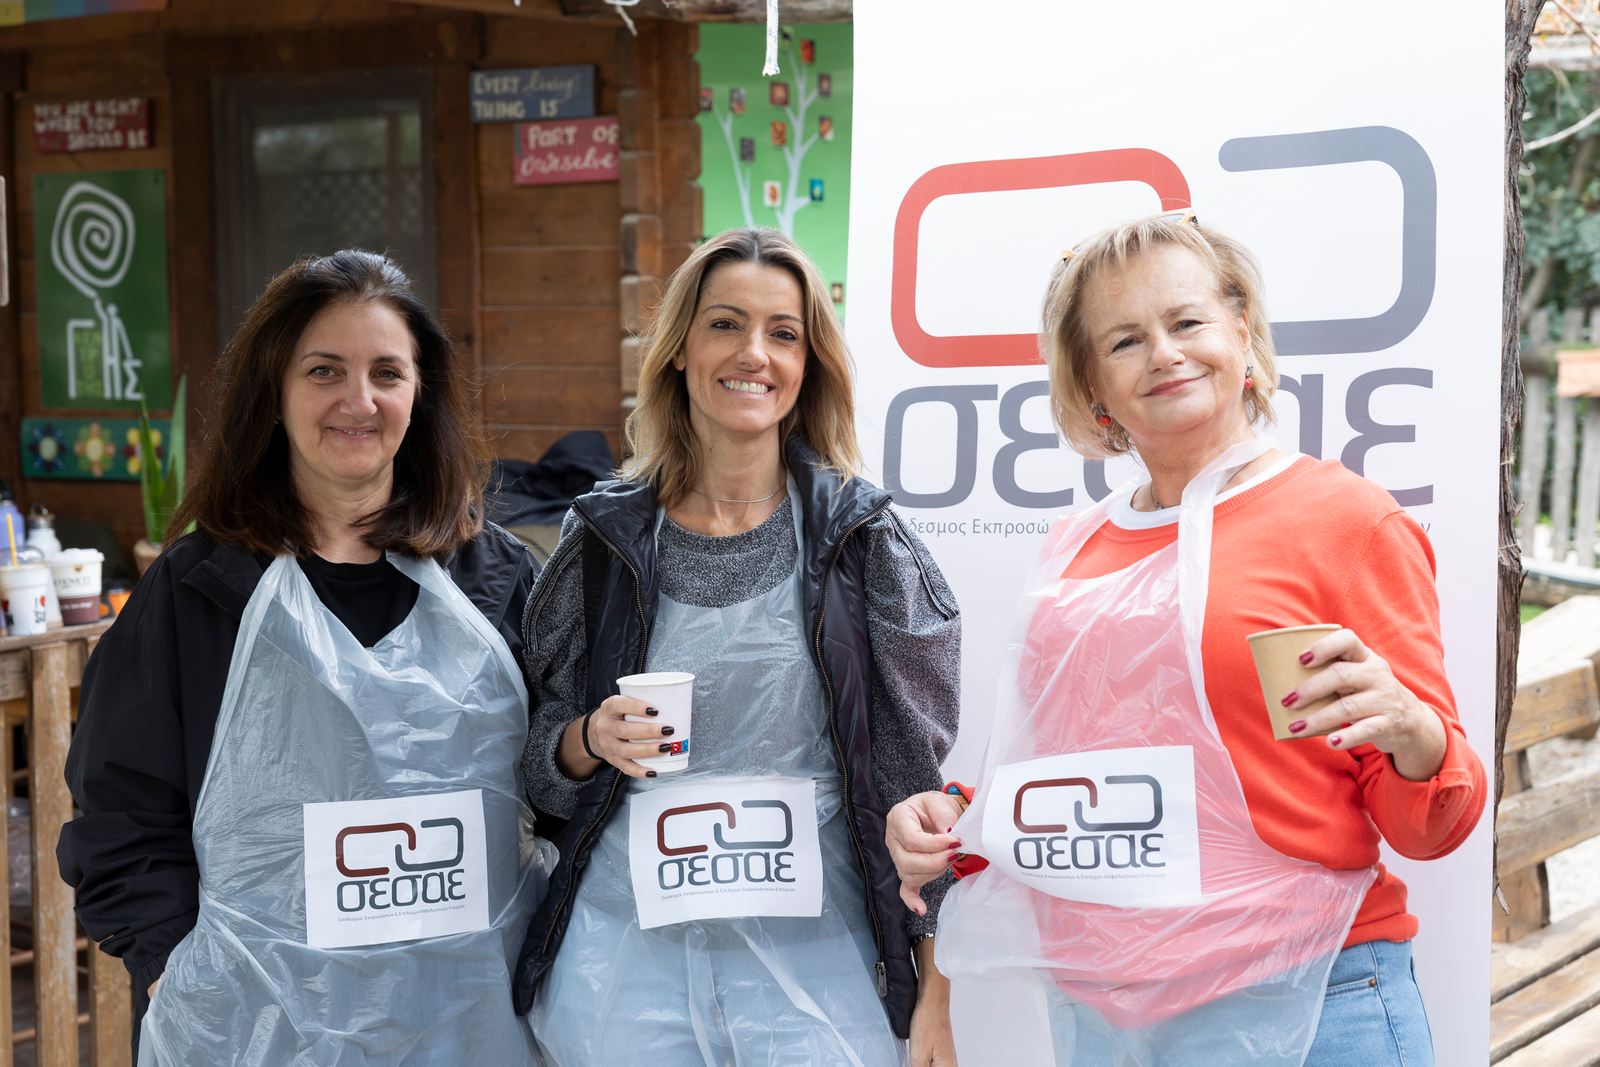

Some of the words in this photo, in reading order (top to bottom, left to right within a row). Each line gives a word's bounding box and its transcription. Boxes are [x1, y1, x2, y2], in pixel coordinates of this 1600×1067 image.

[472, 100, 525, 119] THING
[658, 851, 796, 890] σεσαε
[1013, 833, 1166, 870] σεσαε
[336, 869, 466, 912] σεσαε
